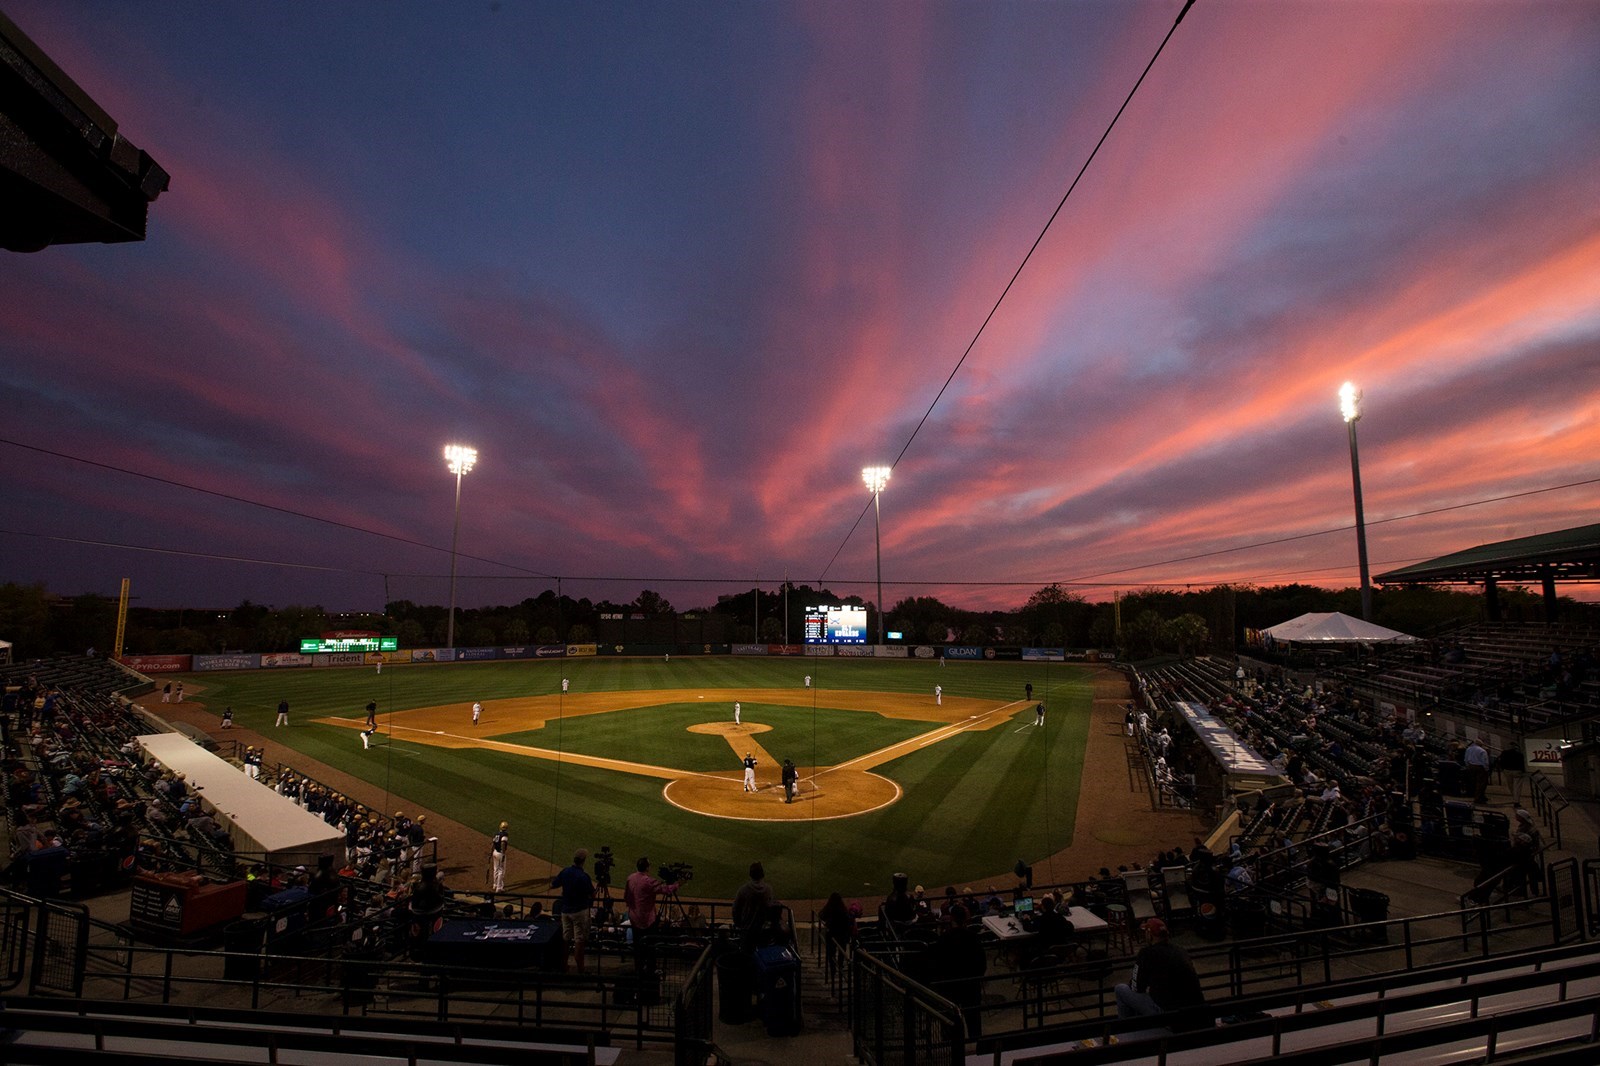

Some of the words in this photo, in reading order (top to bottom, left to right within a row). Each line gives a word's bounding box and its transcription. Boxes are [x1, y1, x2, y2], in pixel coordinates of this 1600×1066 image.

[948, 648, 976, 656] GILDAN
[327, 654, 362, 663] Trident
[1532, 750, 1558, 761] 1250
